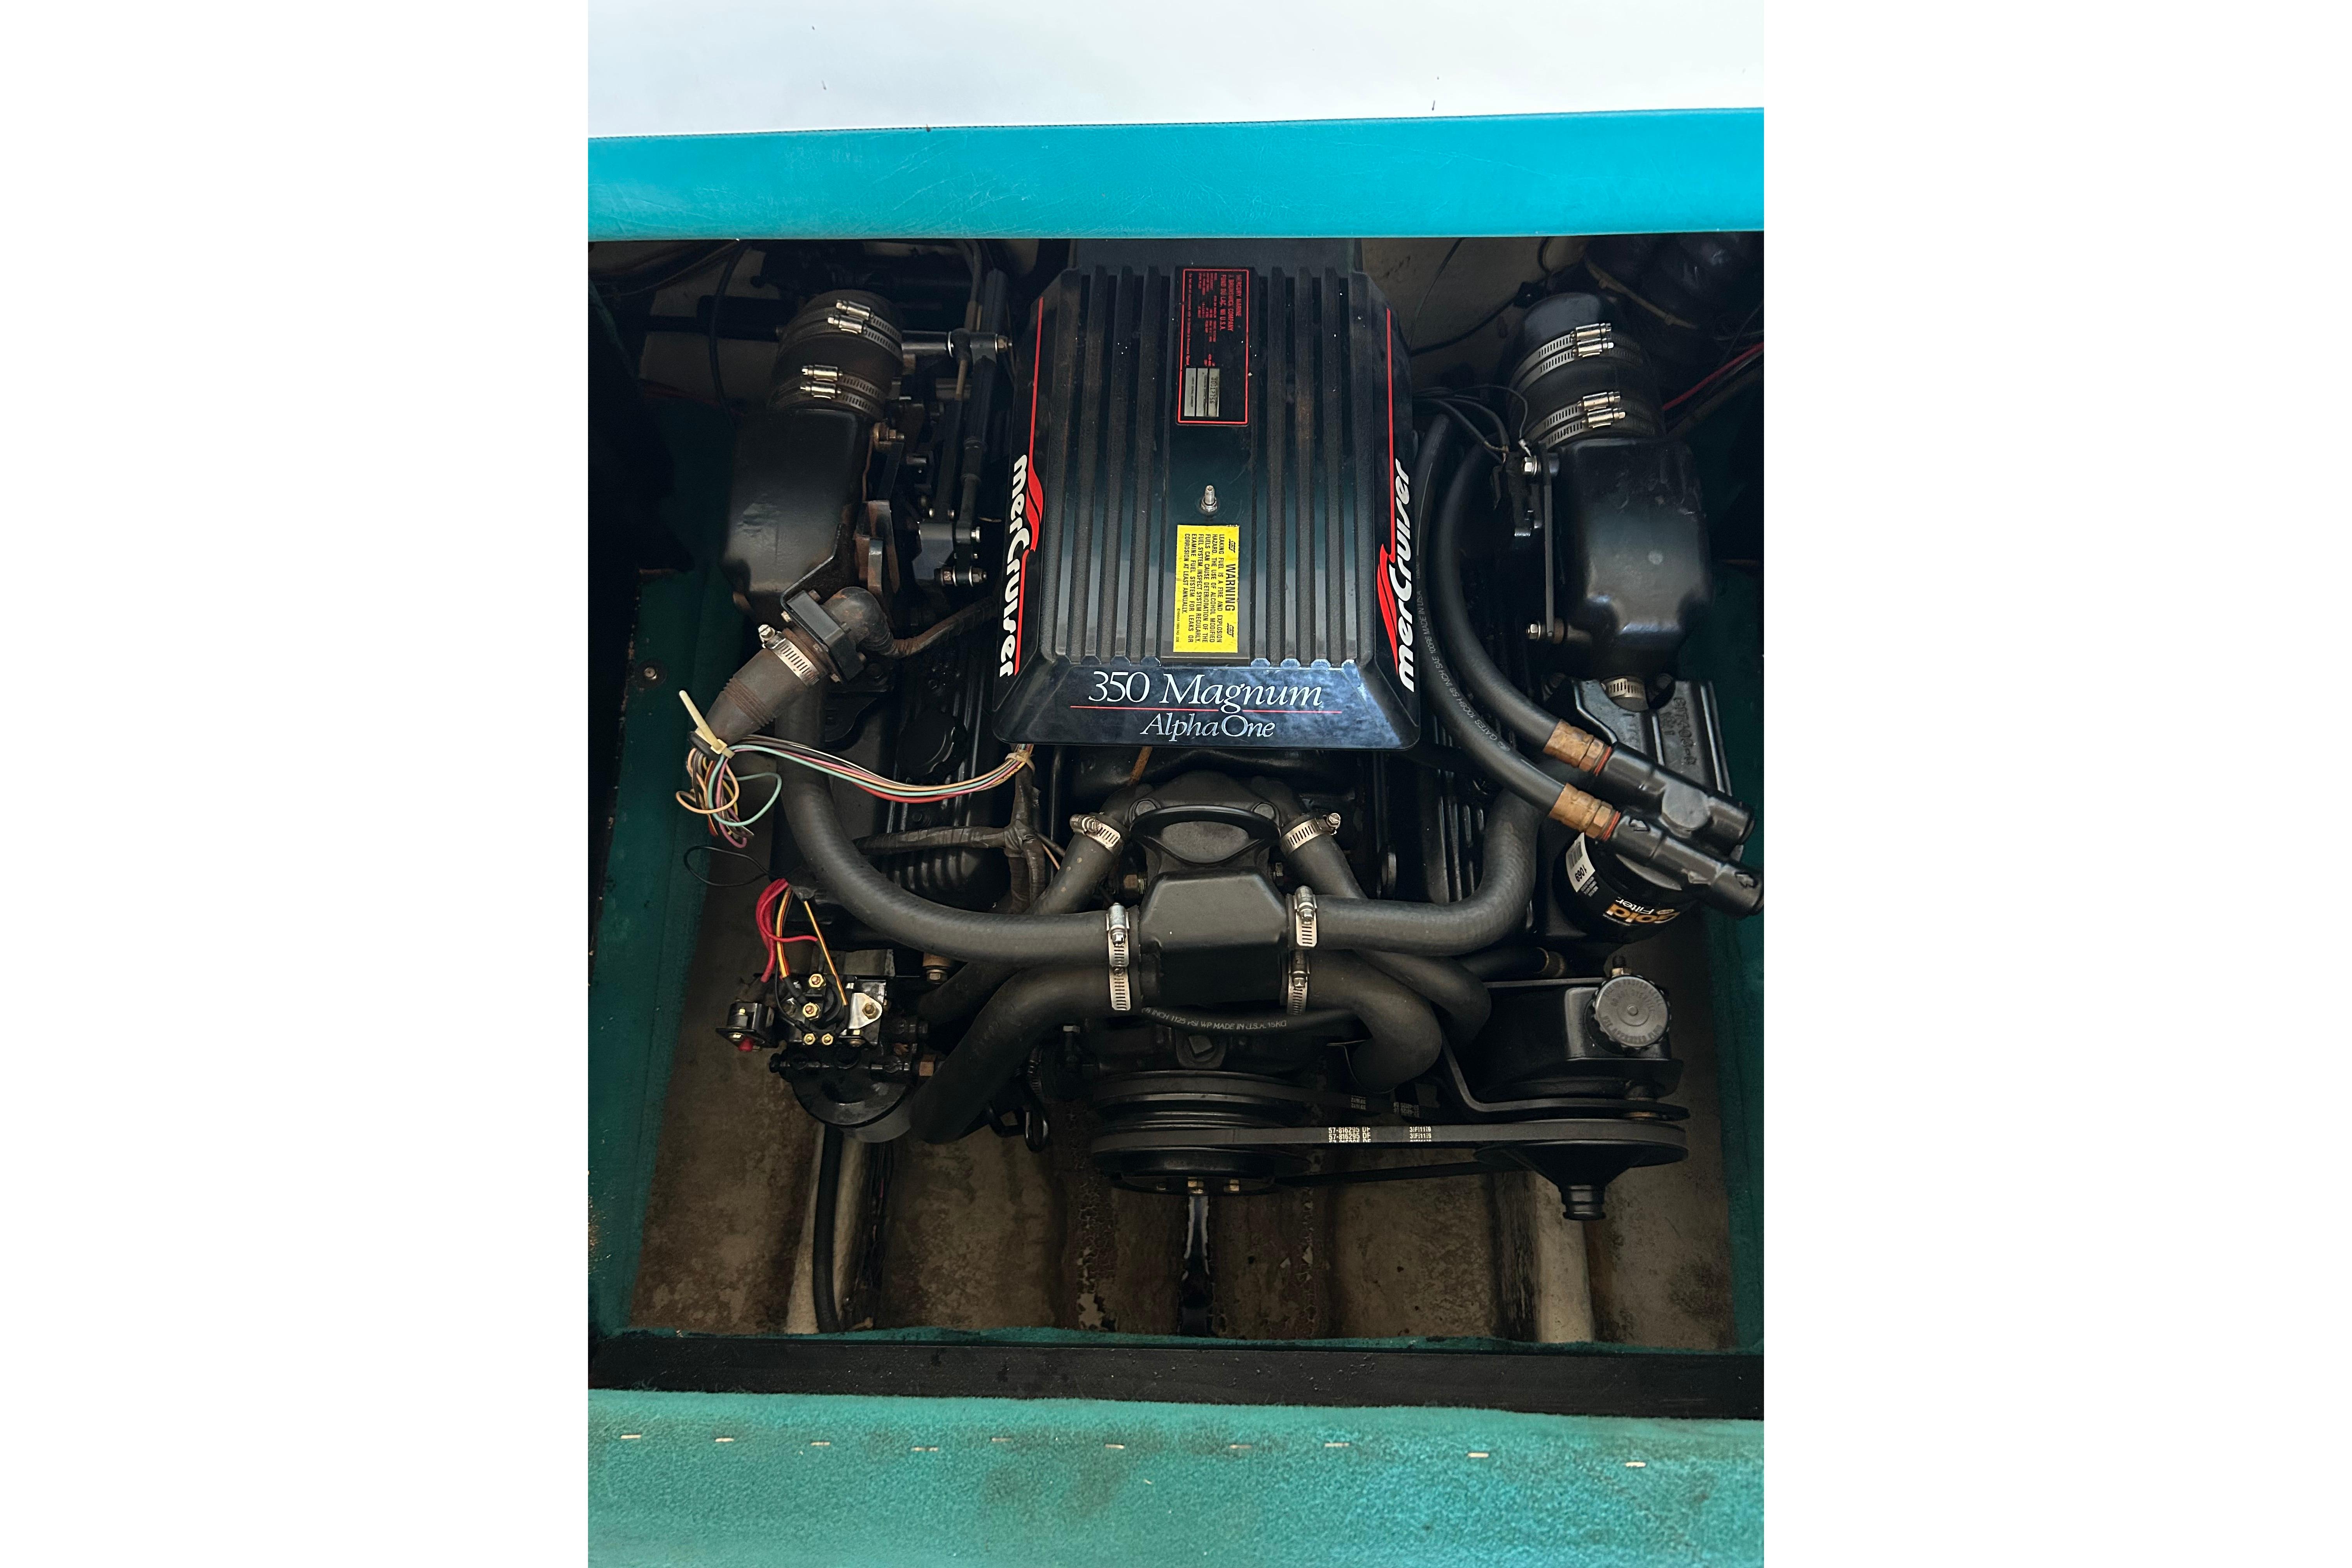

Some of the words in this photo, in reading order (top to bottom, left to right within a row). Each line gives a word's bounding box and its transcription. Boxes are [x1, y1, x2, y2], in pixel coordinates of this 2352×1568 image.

[1225, 564, 1236, 611] WARNING
[1420, 616, 1430, 635] MADE
[1432, 656, 1443, 668] SAE
[1439, 670, 1453, 686] INCH
[1088, 671, 1150, 702] 350
[1159, 674, 1323, 713] Magnum
[1475, 719, 1497, 740] GATES
[1575, 864, 1587, 882] 1069
[1615, 896, 1654, 915] Filter
[1152, 1009, 1170, 1020] INCH
[1170, 1015, 1186, 1024] 1125
